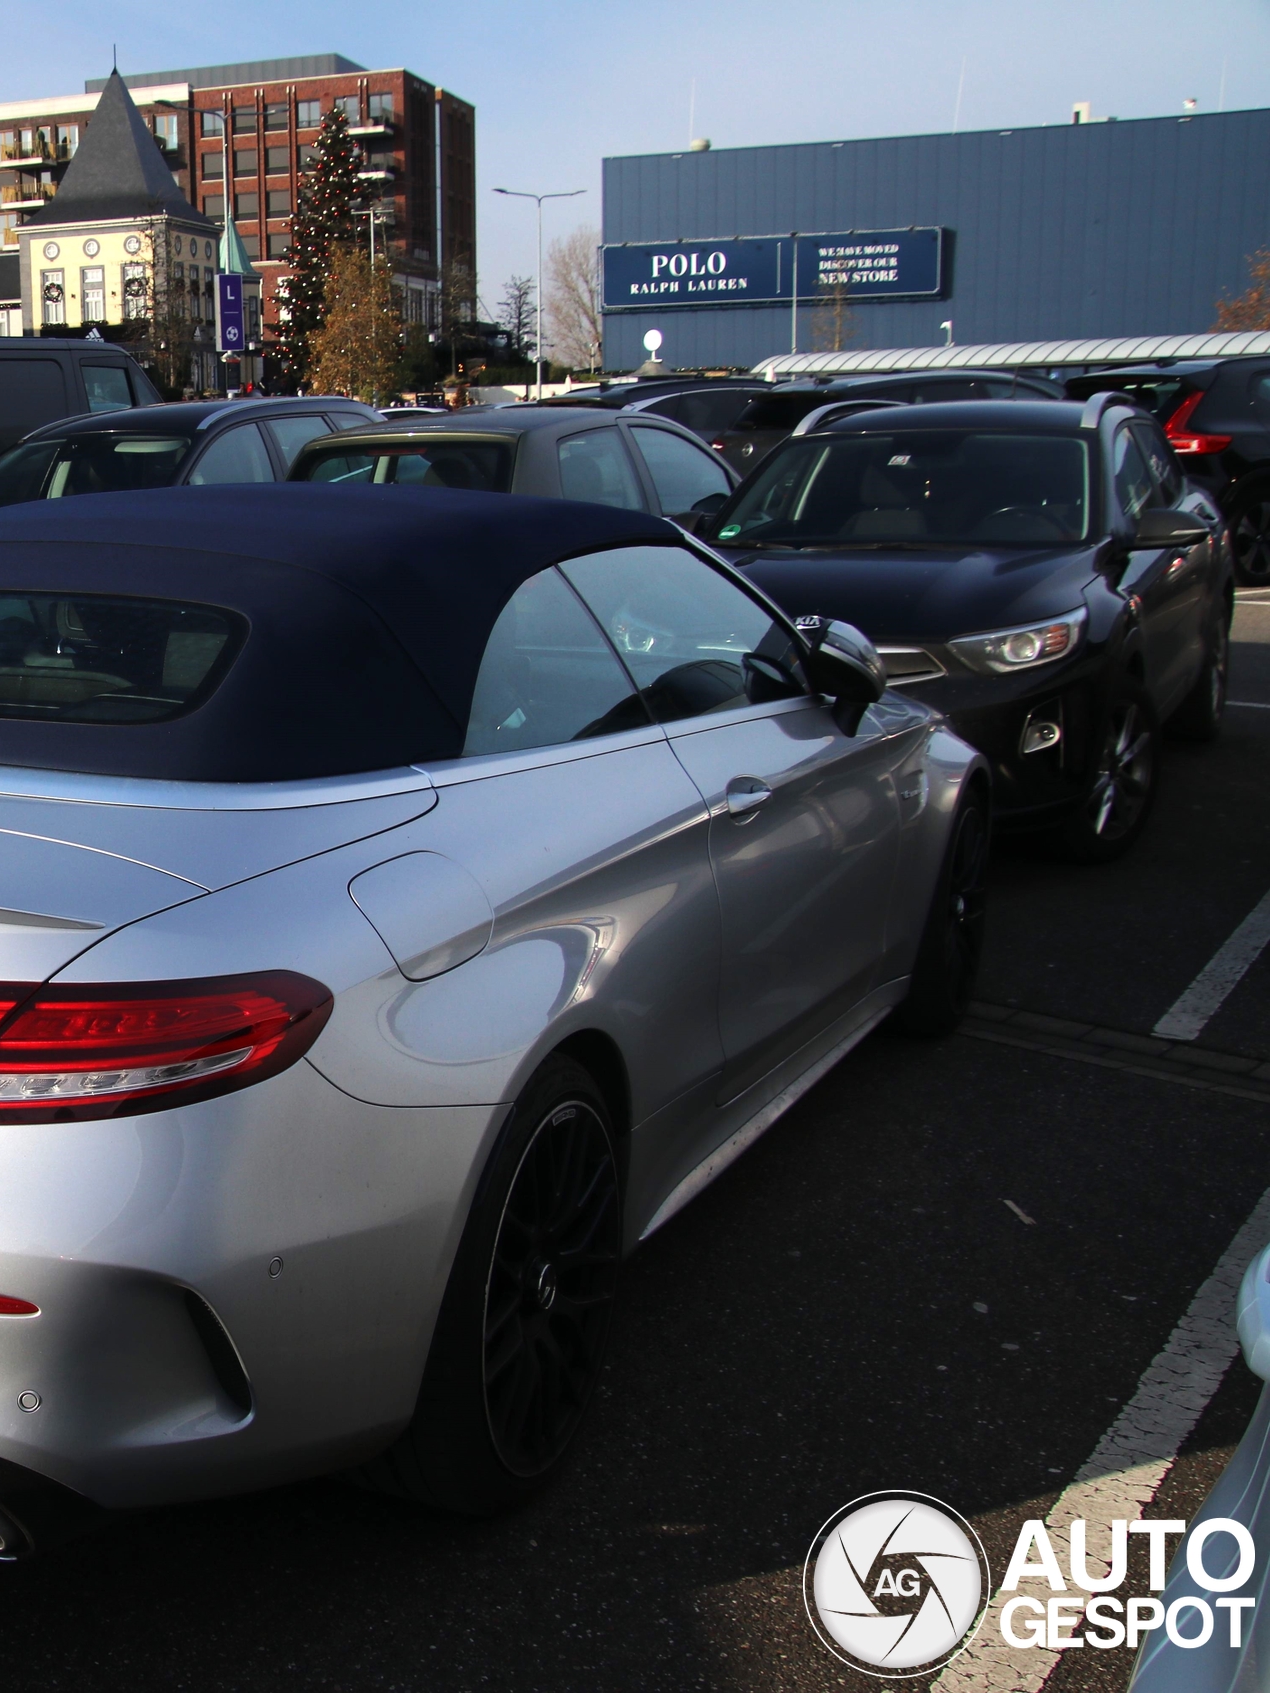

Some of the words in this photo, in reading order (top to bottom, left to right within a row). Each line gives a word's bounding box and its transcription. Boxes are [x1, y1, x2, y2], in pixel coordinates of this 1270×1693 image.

[818, 247, 835, 257] WE
[863, 244, 899, 255] MOVED
[651, 251, 727, 278] POLO
[818, 258, 872, 271] DISCOVER
[873, 257, 898, 268] OUR
[818, 271, 850, 285] NEW
[851, 269, 899, 283] STORE
[226, 285, 235, 300] L
[630, 281, 679, 295] RALPH
[688, 277, 748, 292] LAUREN
[795, 616, 820, 625] KIA
